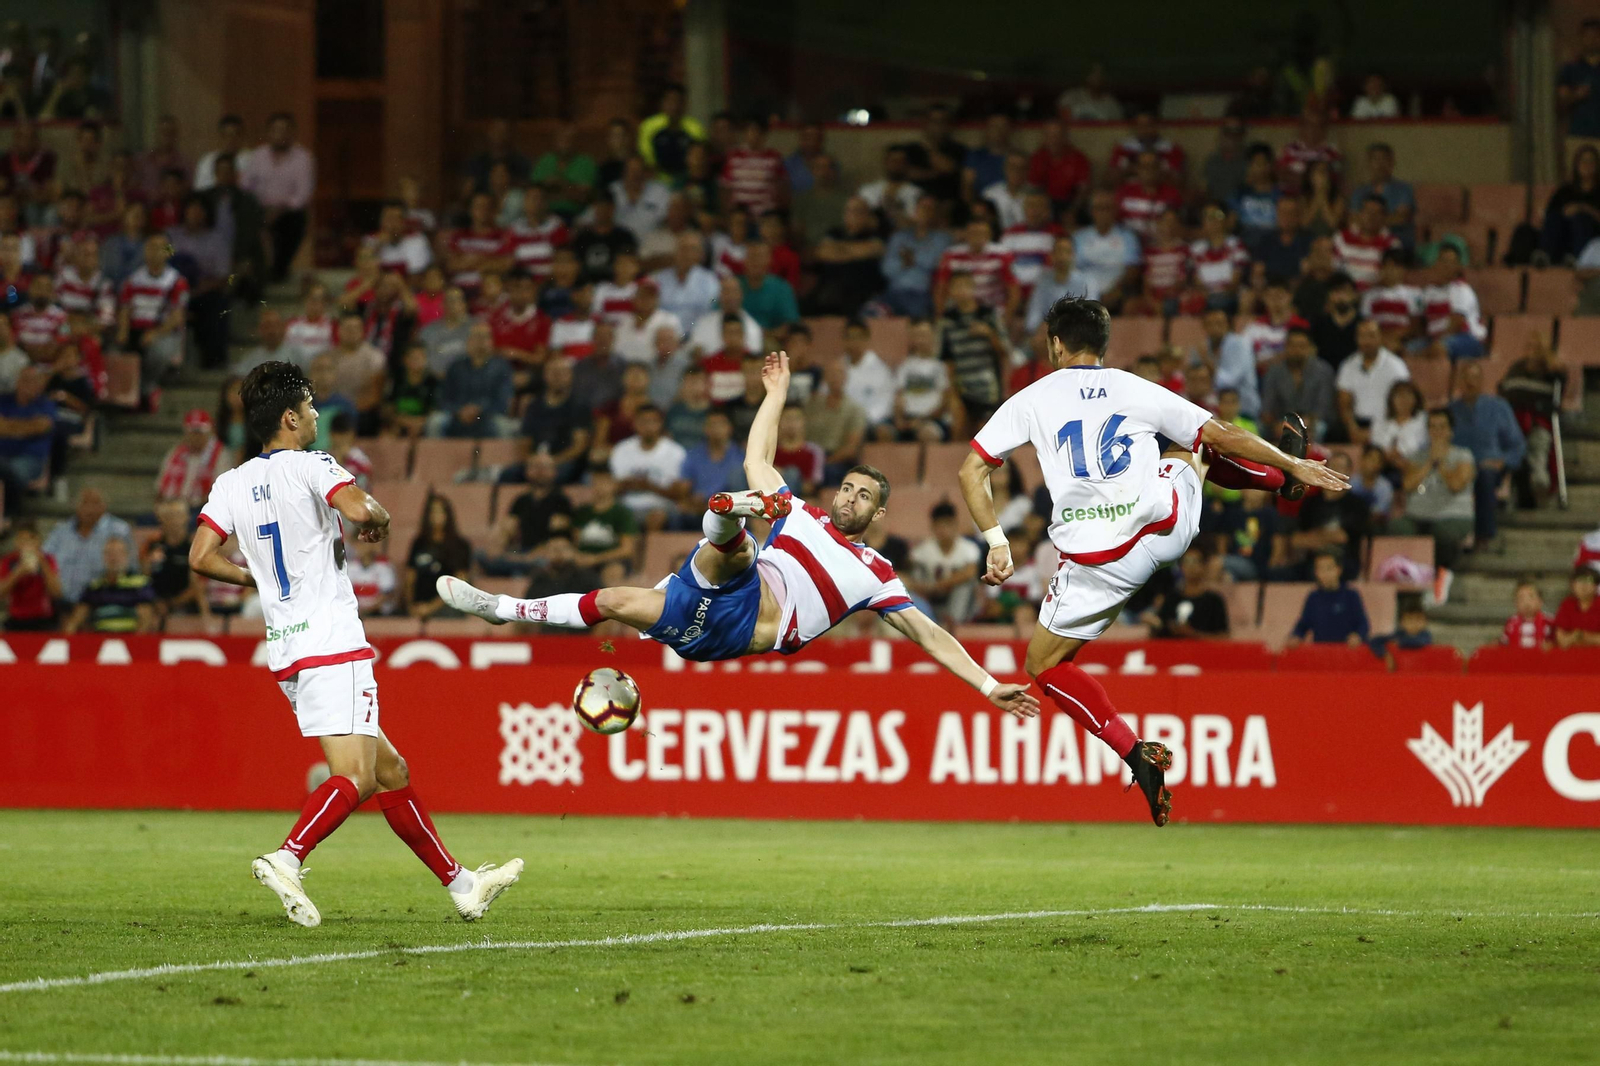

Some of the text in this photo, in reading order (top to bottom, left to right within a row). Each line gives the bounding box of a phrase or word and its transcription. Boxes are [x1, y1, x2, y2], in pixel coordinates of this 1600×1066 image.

[1080, 387, 1107, 400] IZA
[1054, 413, 1134, 479] 16
[256, 521, 290, 601] 7
[362, 691, 373, 723] 7
[608, 709, 910, 783] CERVEZAS
